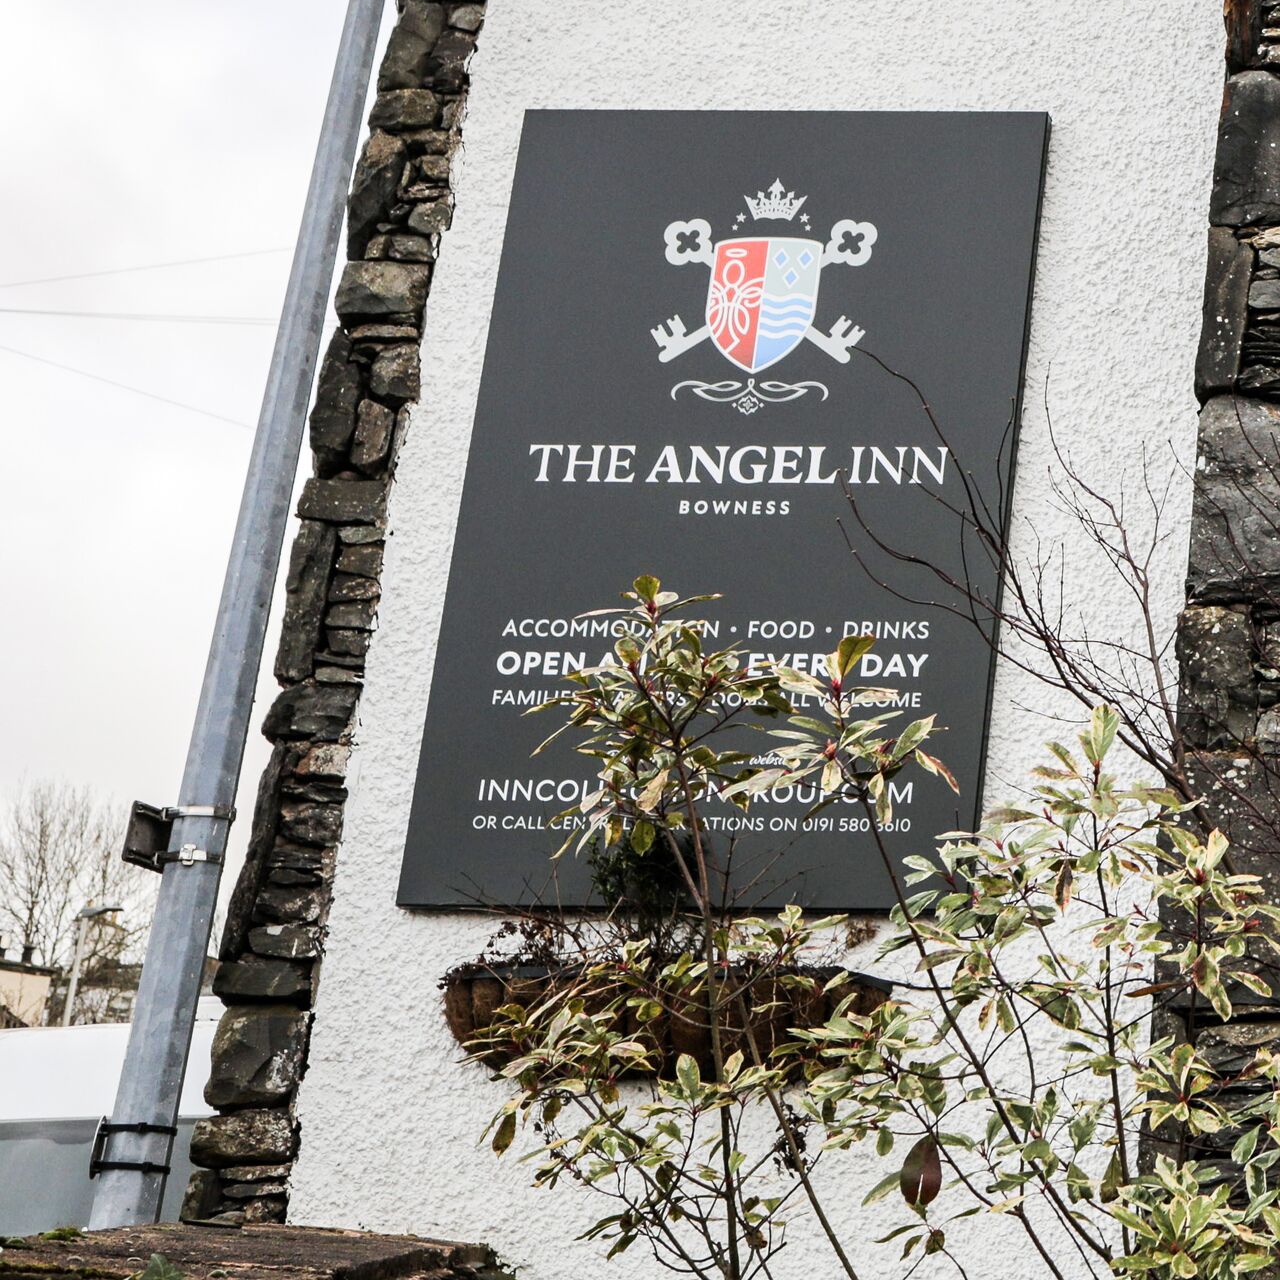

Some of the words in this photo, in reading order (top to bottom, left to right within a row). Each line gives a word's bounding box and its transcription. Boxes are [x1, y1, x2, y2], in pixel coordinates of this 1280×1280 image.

[529, 444, 636, 483] THE
[645, 445, 838, 484] ANGEL
[850, 446, 948, 484] INN
[678, 500, 792, 516] BOWNESS
[501, 618, 720, 638] ACCOMMODIN
[747, 620, 815, 639] FOOD
[843, 621, 930, 639] DRINKS
[496, 651, 587, 676] OPEN
[593, 651, 654, 676] AL
[747, 653, 852, 678] EVER
[859, 653, 929, 678] DAY
[817, 692, 922, 708] WLME
[472, 815, 498, 830] OR
[501, 815, 545, 830] CALL
[551, 816, 631, 831] CENRL
[769, 817, 798, 832] ON
[802, 818, 834, 832] 0191
[838, 818, 871, 832] 580
